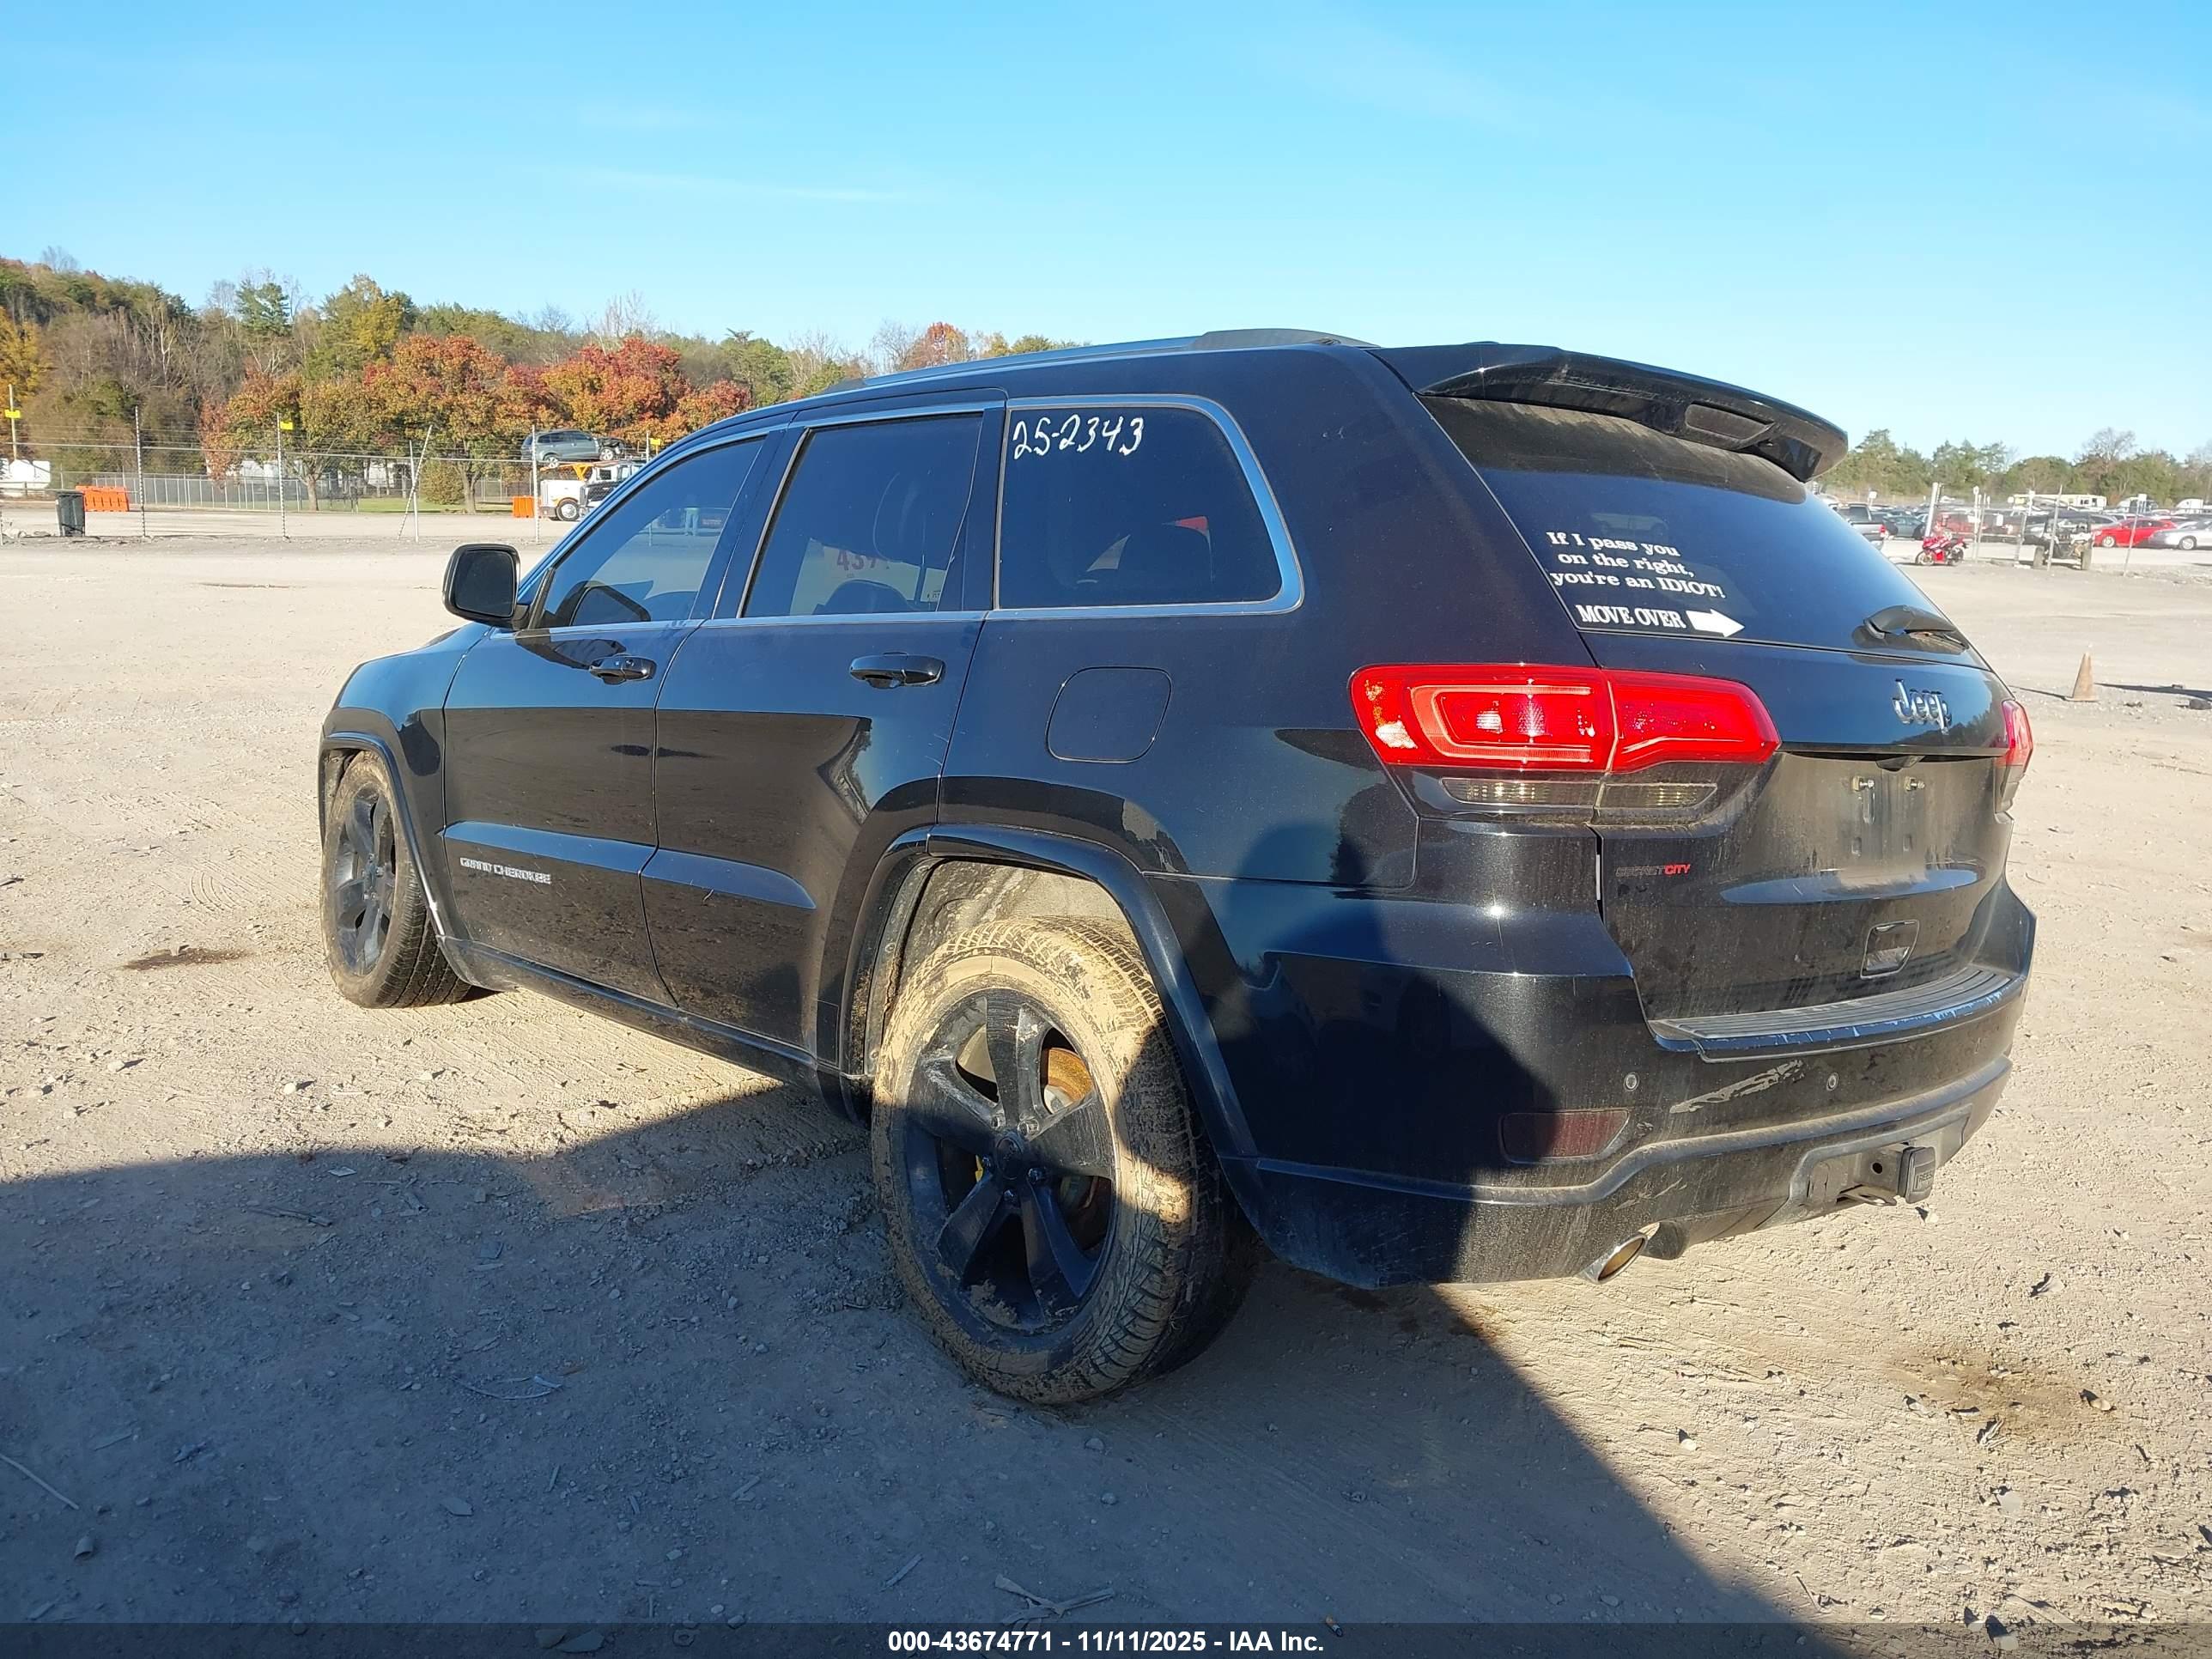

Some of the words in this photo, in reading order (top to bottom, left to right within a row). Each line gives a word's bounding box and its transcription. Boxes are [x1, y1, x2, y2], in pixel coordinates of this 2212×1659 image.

[1013, 414, 1144, 459] 25-2343
[1546, 532, 1570, 544] If
[1571, 533, 1586, 545] I
[1588, 537, 1638, 550] pass
[1640, 543, 1681, 556] you
[1558, 553, 1589, 564] on
[1592, 552, 1630, 568] the
[1632, 557, 1695, 578] right,
[1549, 570, 1620, 586] you're
[1625, 576, 1656, 589] an
[1656, 576, 1726, 599] IDIOT!
[1575, 604, 1635, 624] MOVE
[1634, 607, 1686, 629] OVER
[1892, 678, 1953, 736] Jeep
[459, 857, 493, 873] GRAND
[493, 864, 552, 884] CHEROKEE
